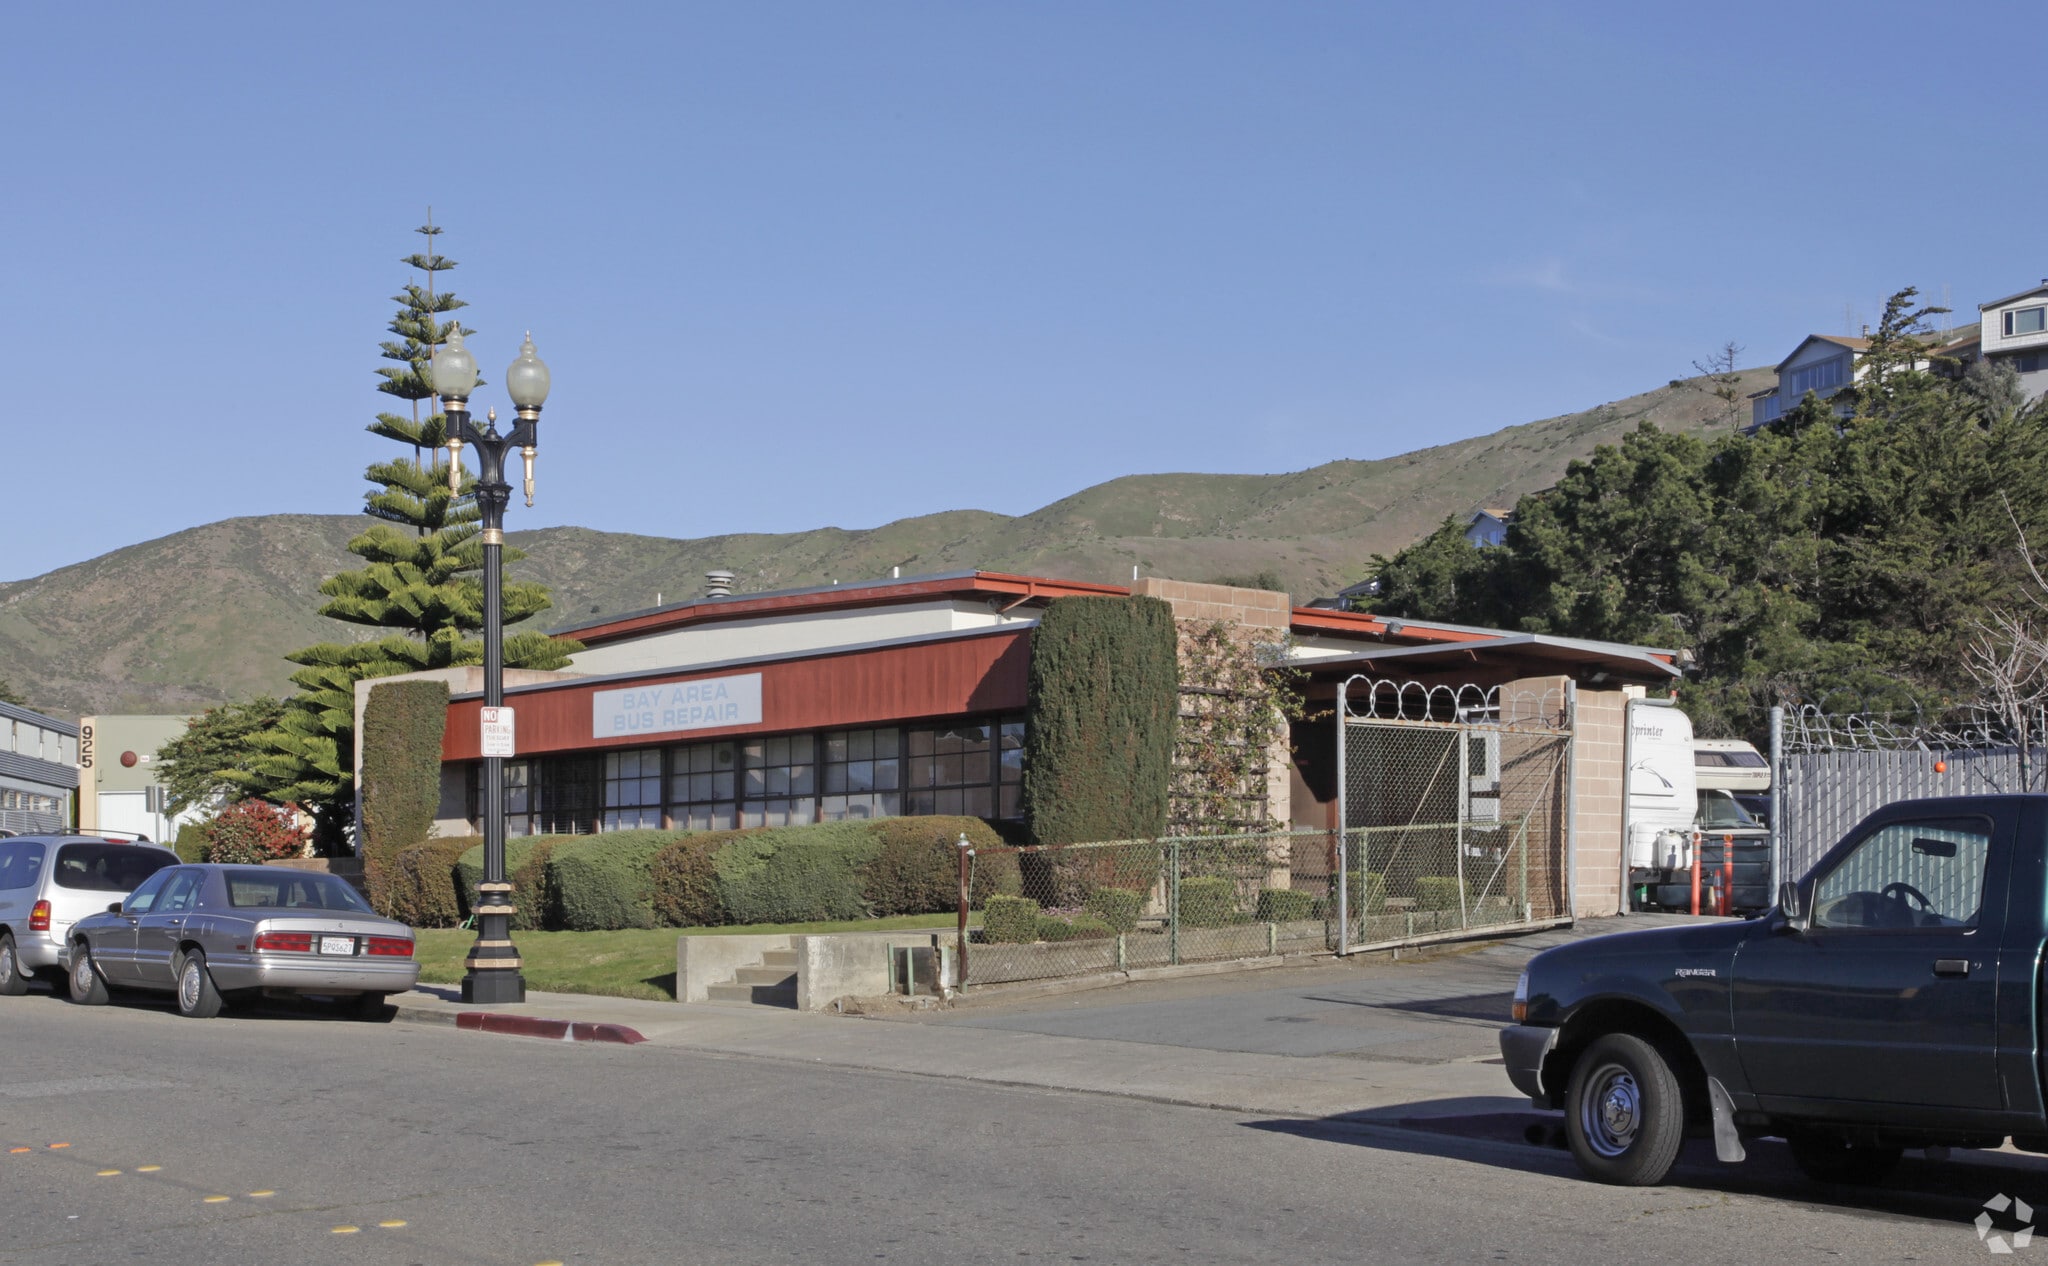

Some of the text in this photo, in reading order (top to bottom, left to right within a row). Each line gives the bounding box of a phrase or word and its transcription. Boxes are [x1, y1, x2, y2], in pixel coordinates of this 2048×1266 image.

[623, 682, 728, 710] BAY AREA
[483, 710, 497, 721] NO
[613, 703, 738, 731] BUS REPAIR
[485, 725, 511, 734] PARKING
[82, 725, 94, 768] 925
[1675, 968, 1716, 978] RANGER
